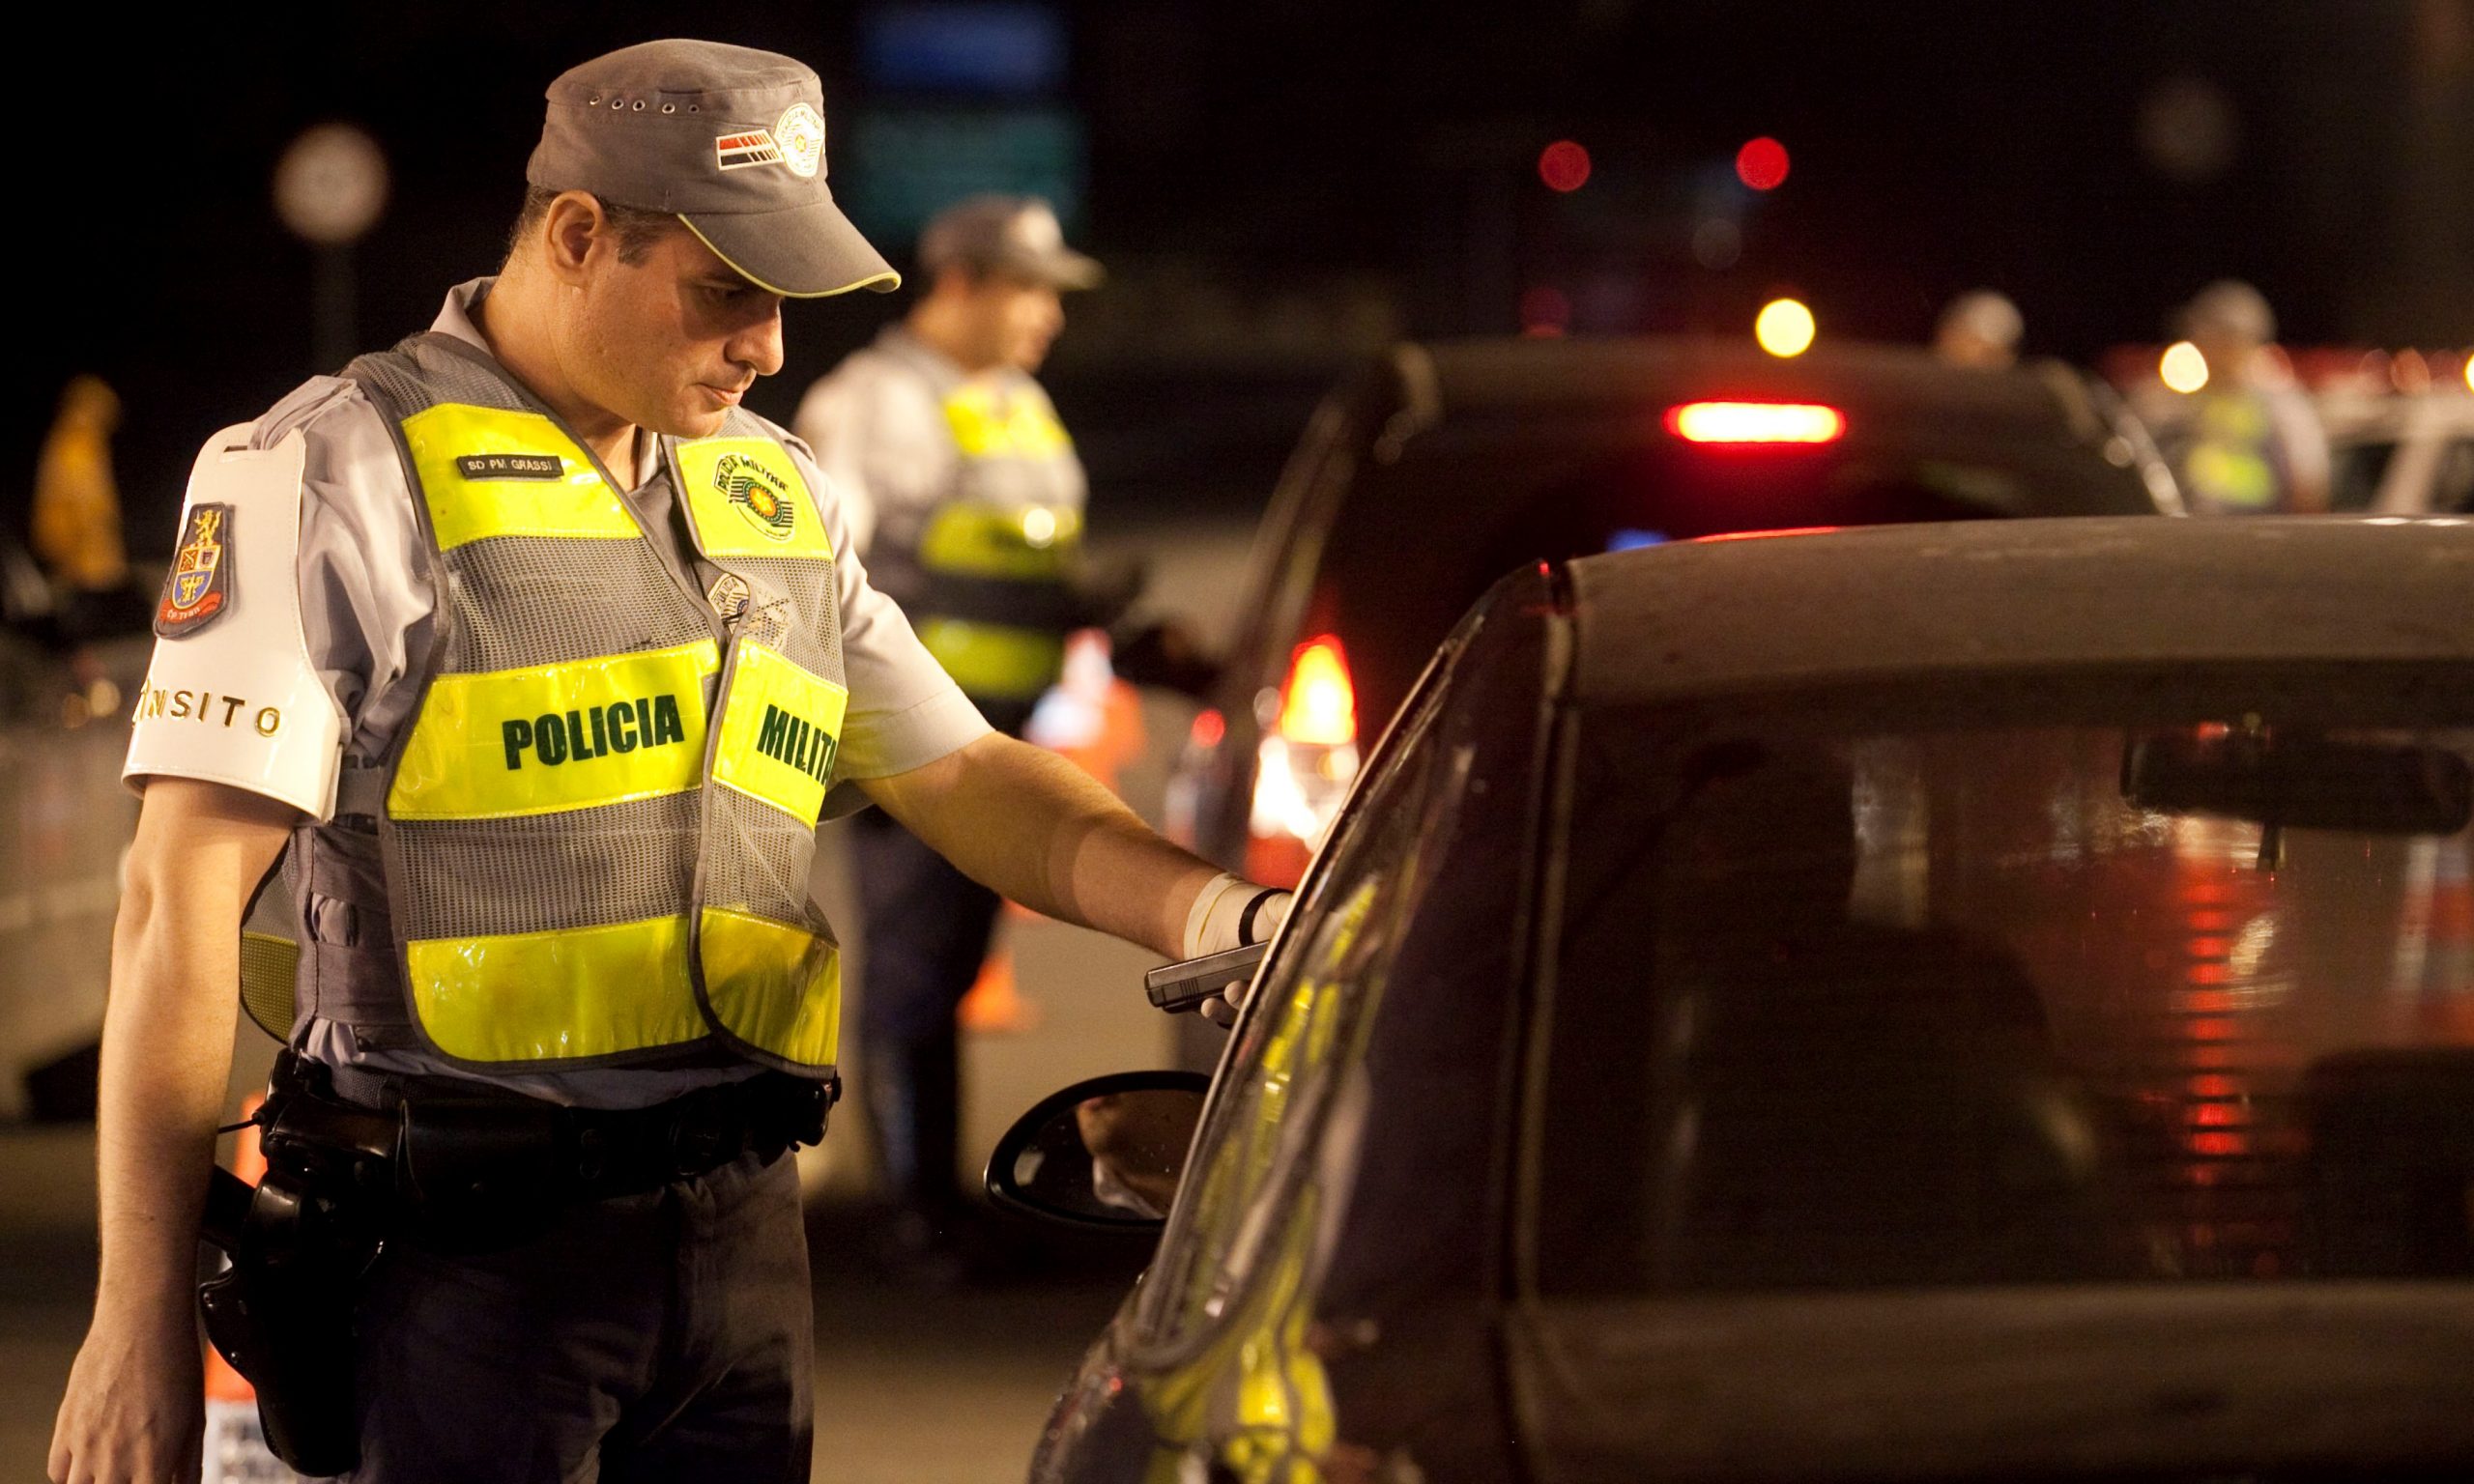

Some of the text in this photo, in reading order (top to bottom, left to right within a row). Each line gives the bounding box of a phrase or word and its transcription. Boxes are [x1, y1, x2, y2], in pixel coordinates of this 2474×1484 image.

[468, 458, 553, 471] SD PM GRASSI
[502, 694, 684, 770] POLICIA
